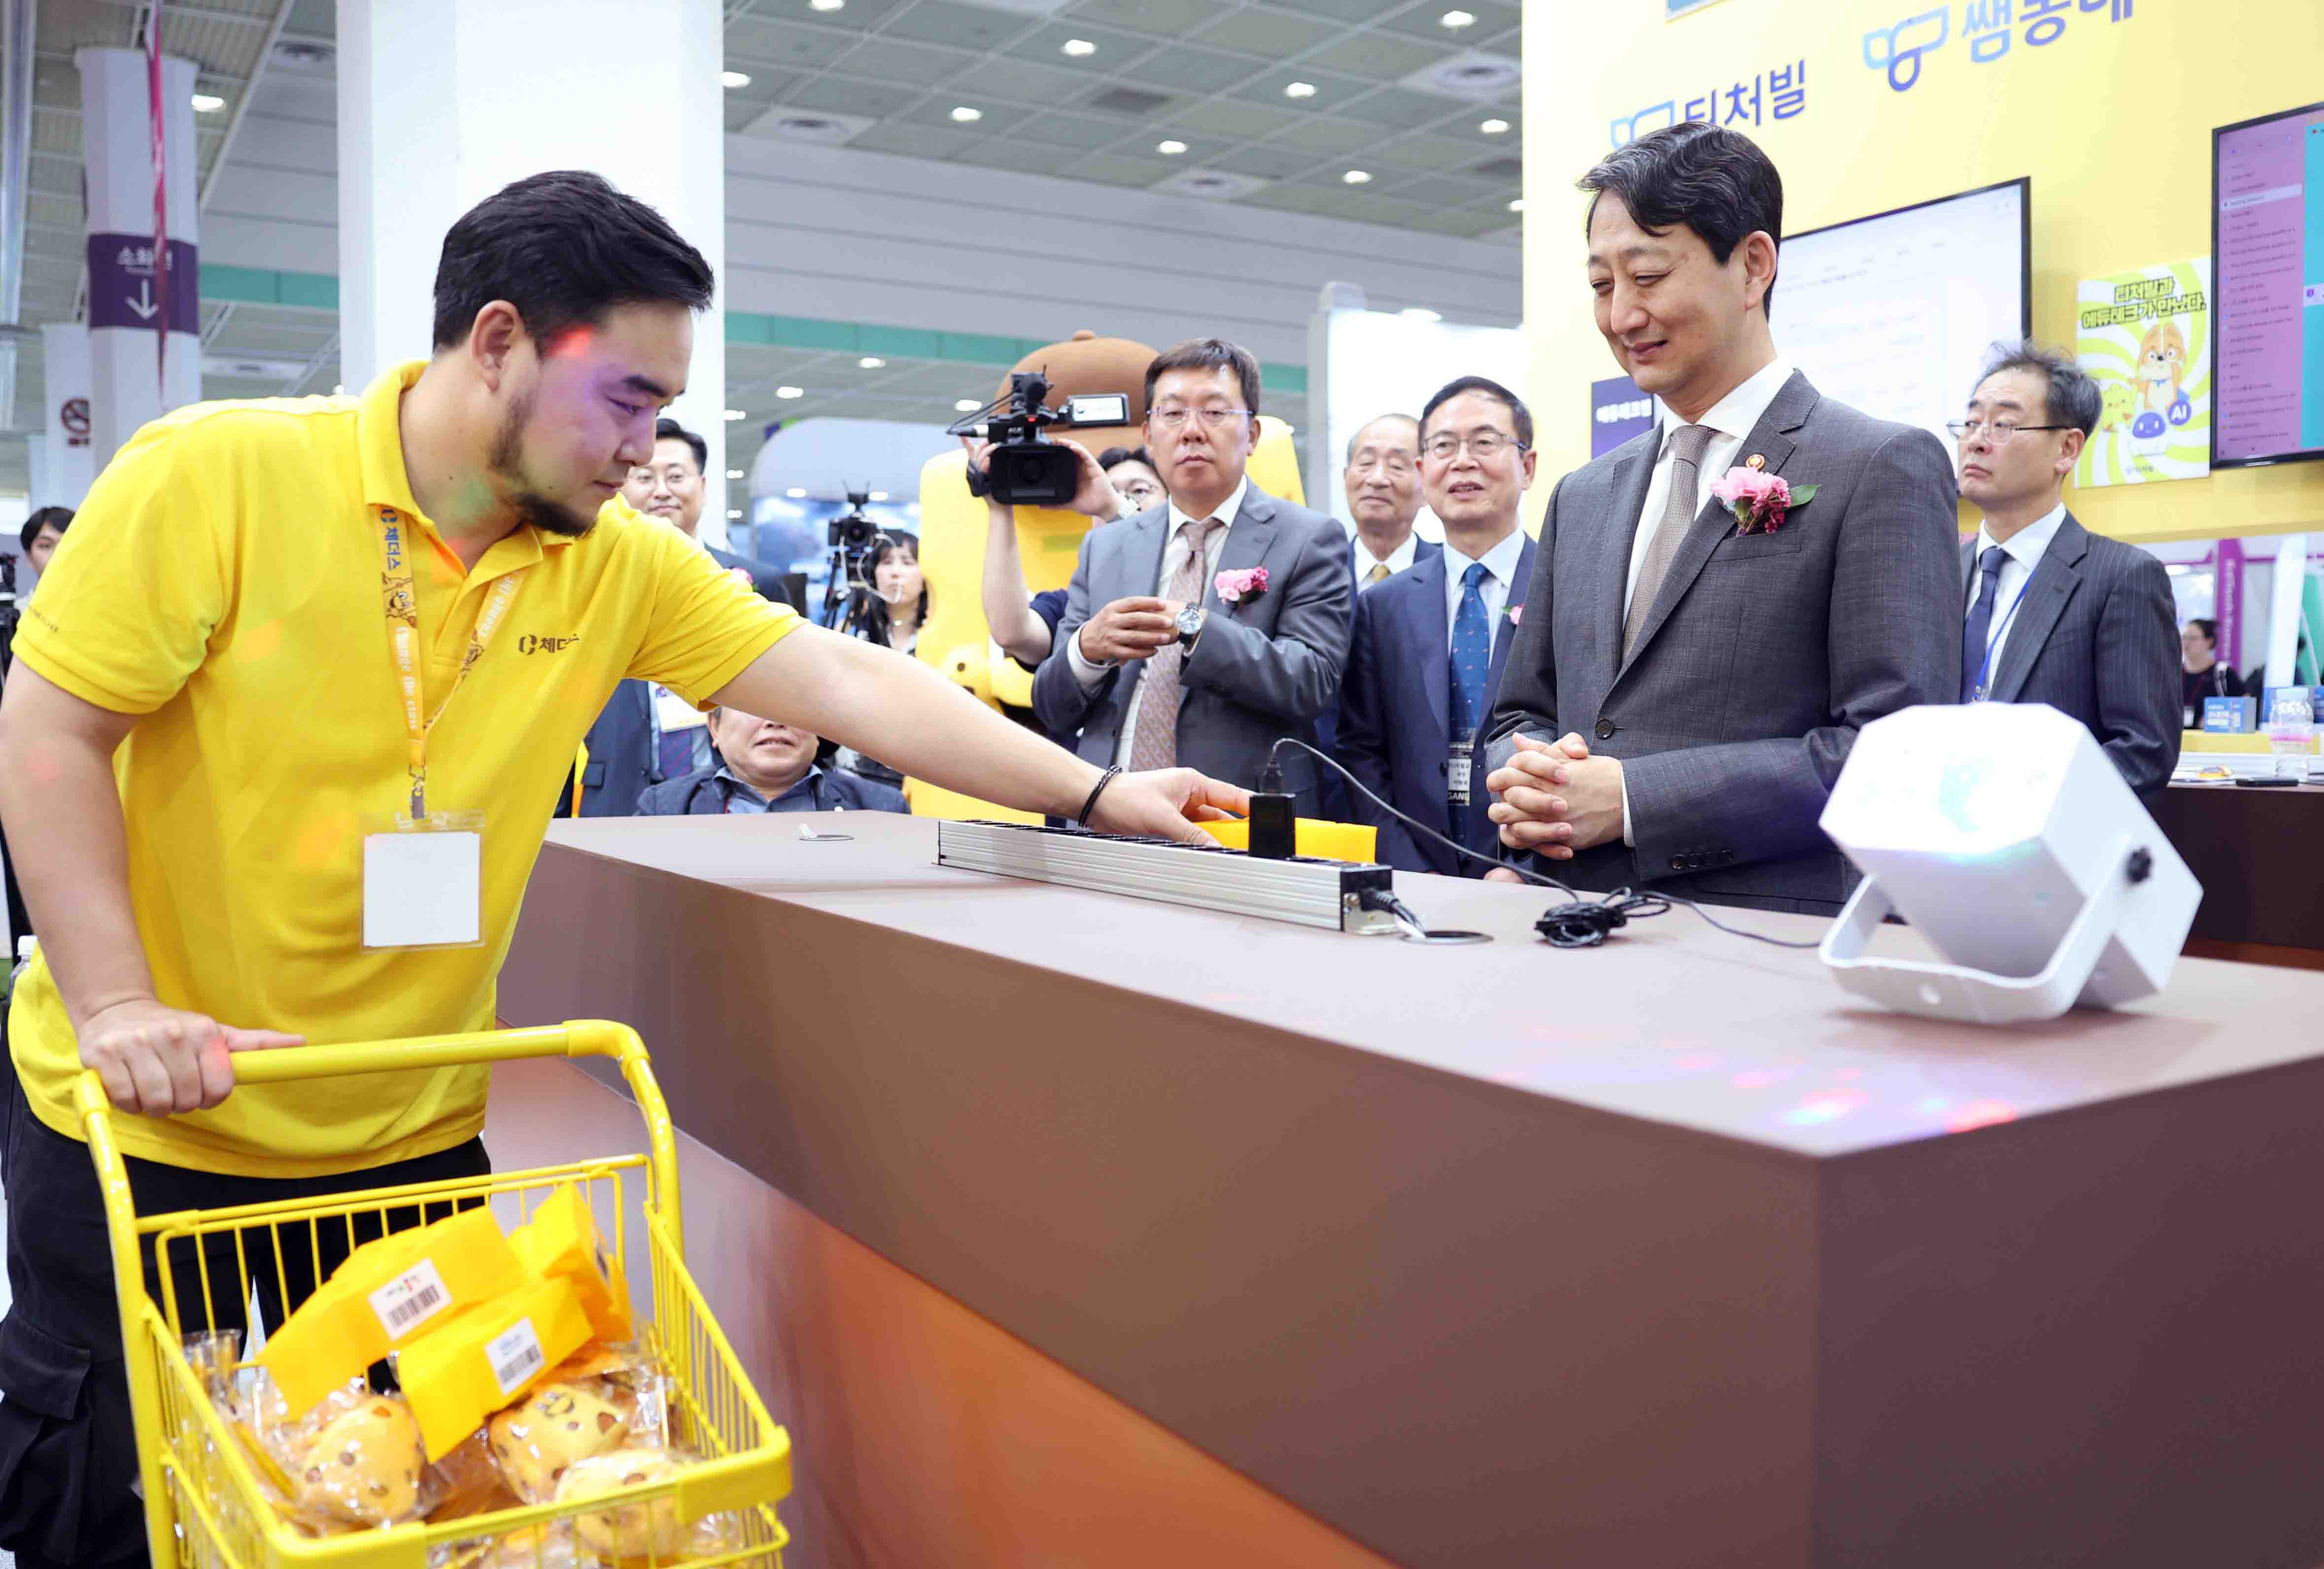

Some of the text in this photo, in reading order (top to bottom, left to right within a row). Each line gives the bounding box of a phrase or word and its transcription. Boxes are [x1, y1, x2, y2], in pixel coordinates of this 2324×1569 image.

[1685, 59, 1805, 127] 티처빌
[2115, 277, 2174, 303] 티처빌과
[2082, 299, 2154, 329] 에듀테크가
[2171, 404, 2187, 420] AI
[385, 526, 401, 570] 체더스
[395, 626, 418, 730] Change the class
